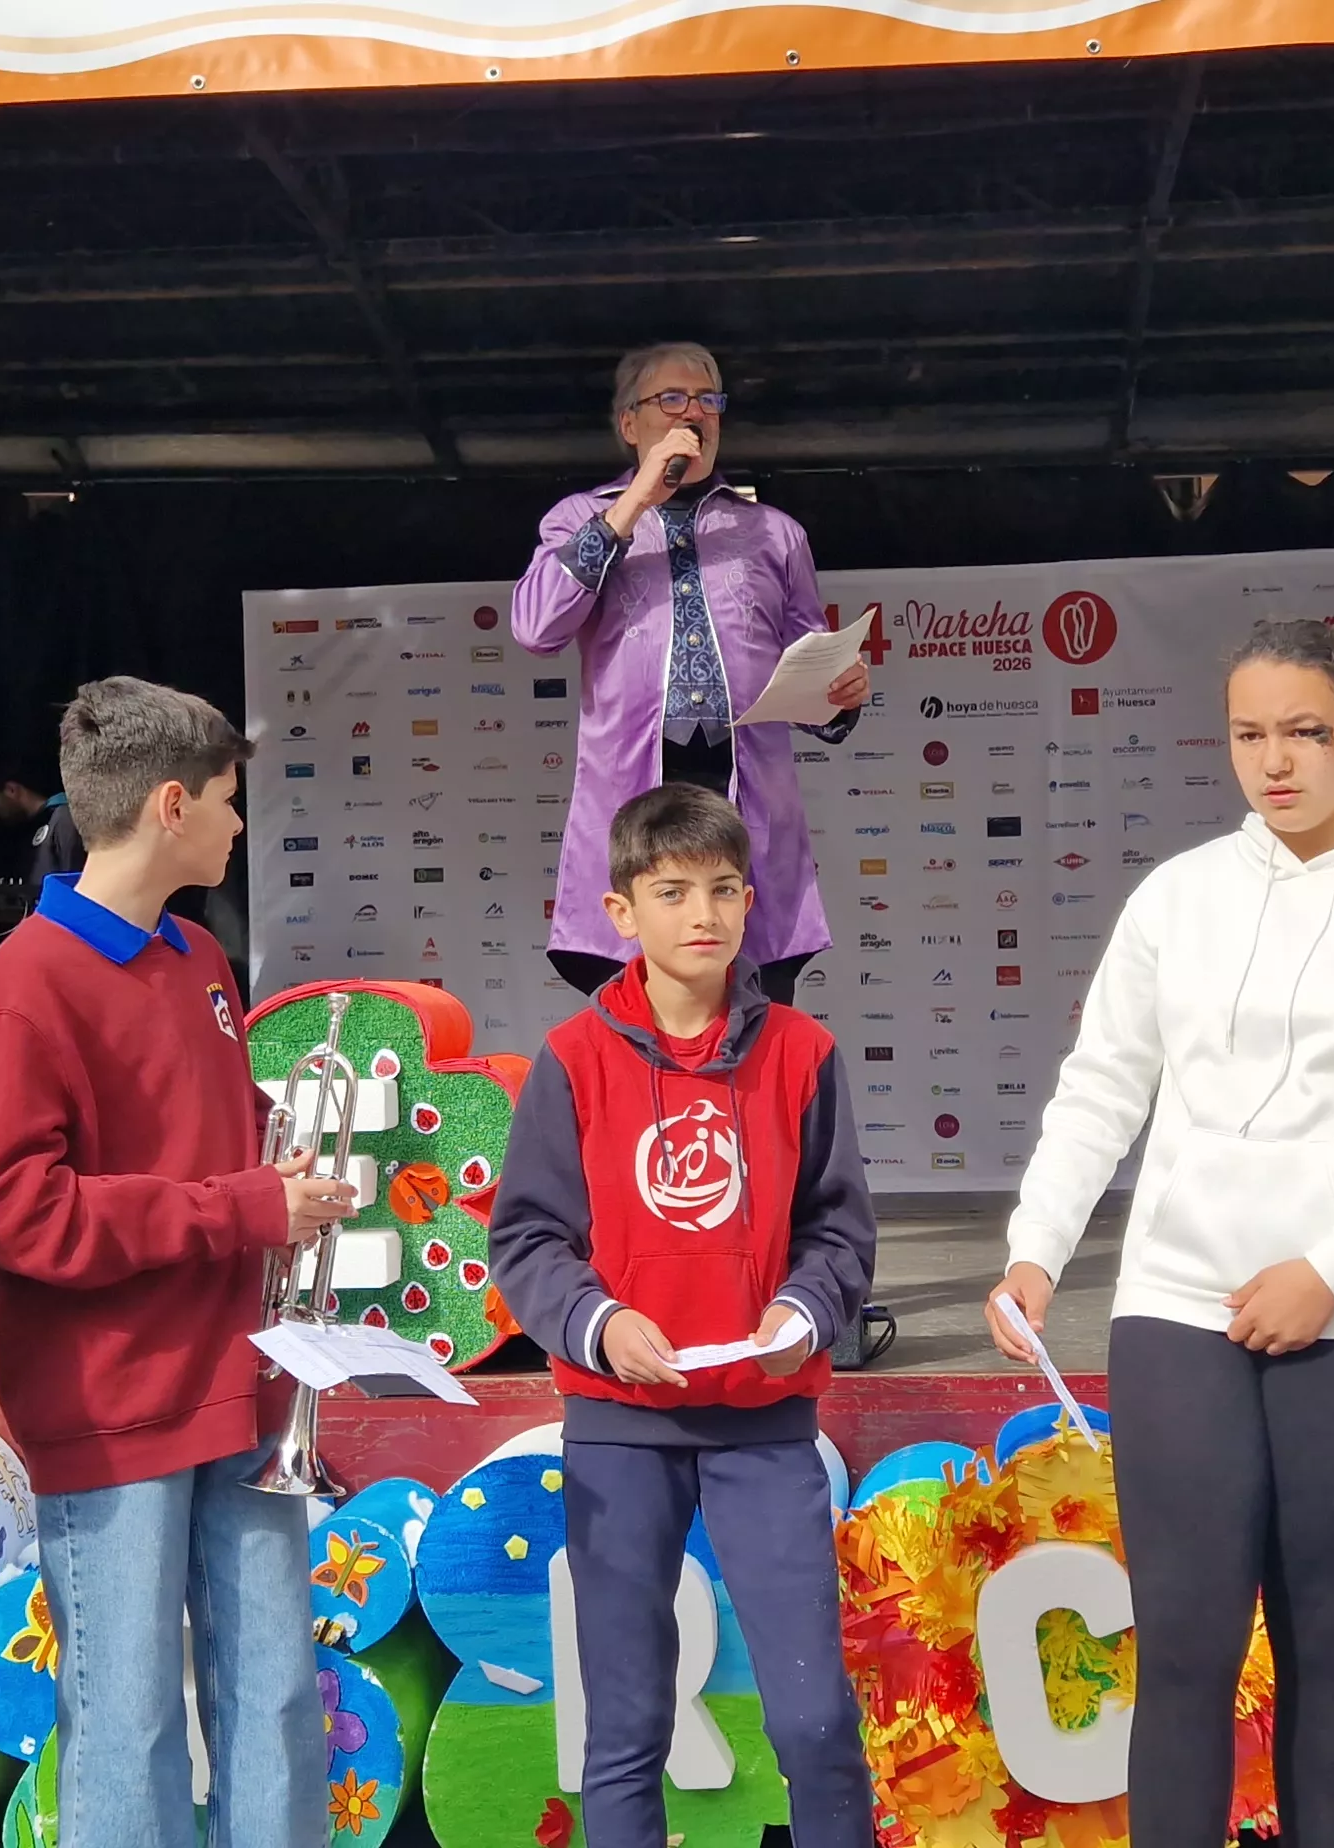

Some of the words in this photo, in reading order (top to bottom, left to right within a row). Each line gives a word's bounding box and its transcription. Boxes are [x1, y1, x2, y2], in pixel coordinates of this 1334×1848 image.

[905, 599, 1034, 640] Marcha
[908, 640, 967, 659] ASPACE
[972, 638, 1033, 656] HUESCA
[992, 657, 1032, 673] 2026
[1102, 685, 1173, 698] Ayuntamiento
[946, 700, 978, 715] hoya
[979, 700, 995, 712] de
[995, 698, 1039, 712] huesca
[1102, 699, 1114, 708] de
[1117, 697, 1156, 708] Huesca
[859, 932, 878, 941] alto
